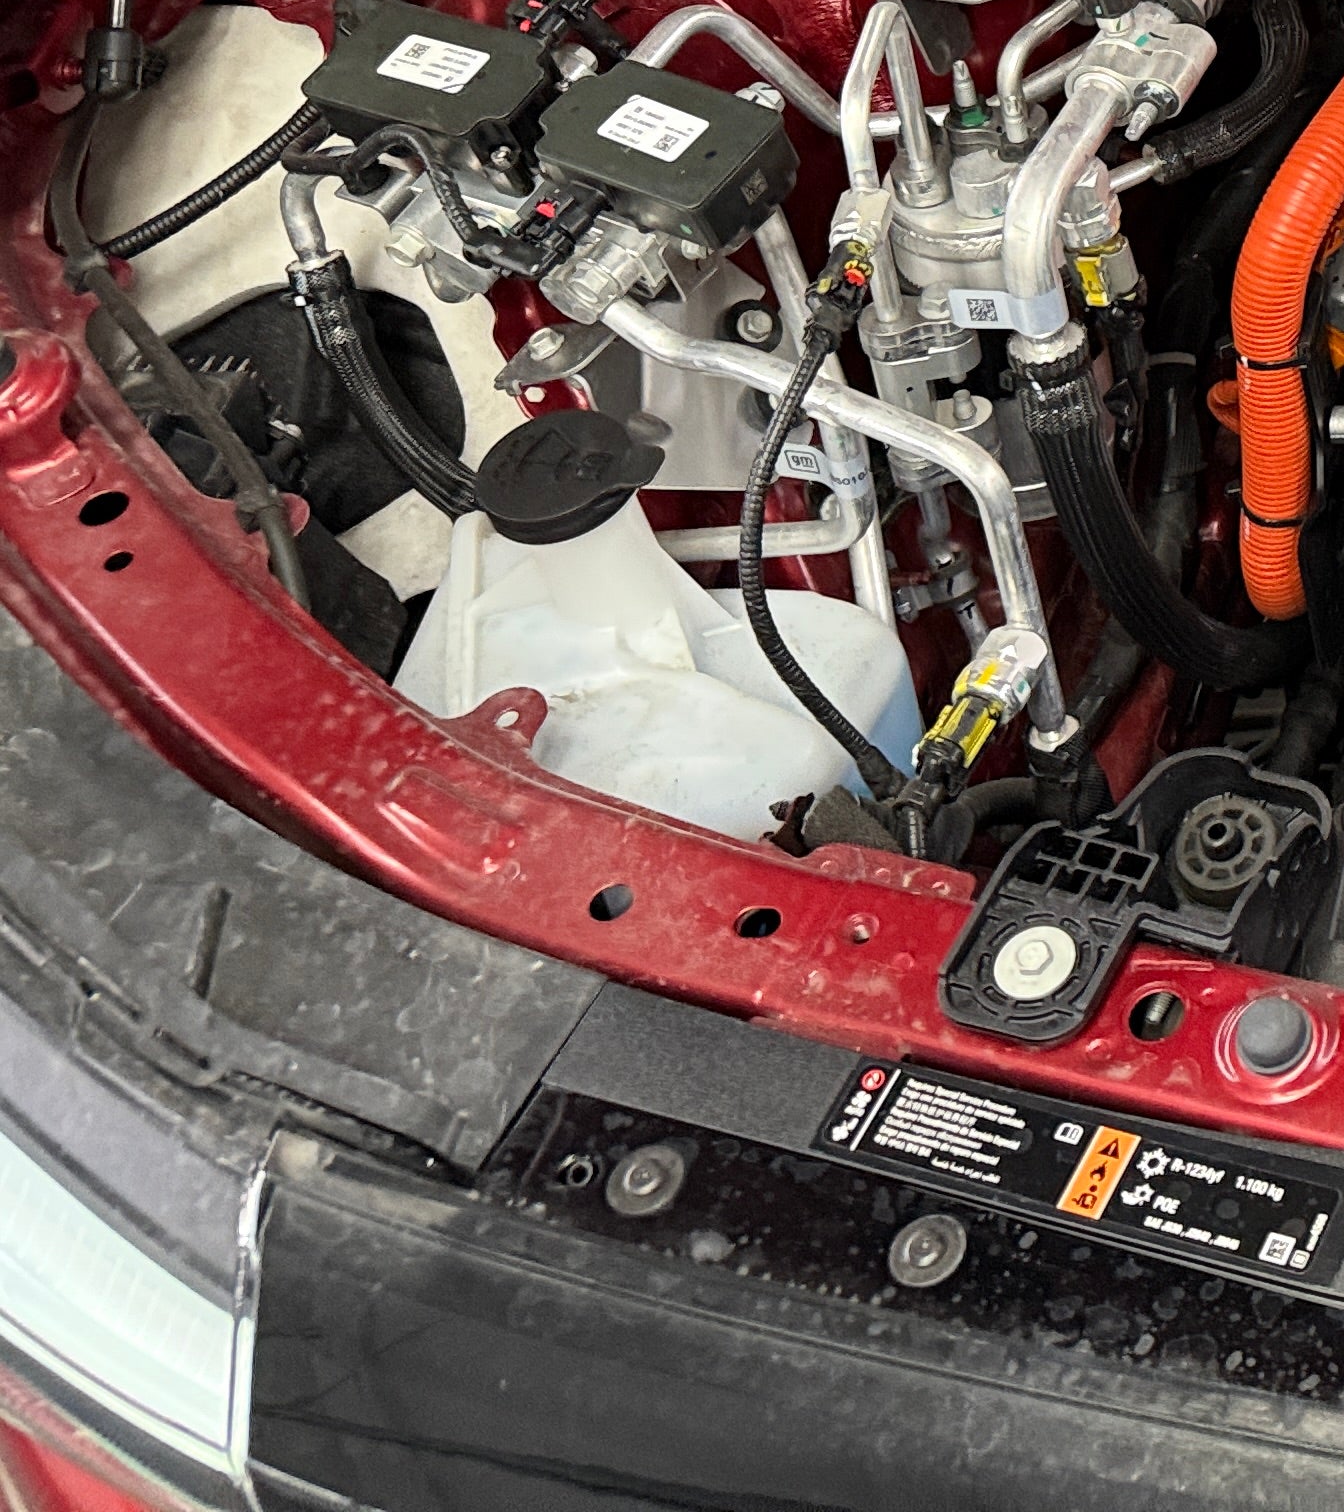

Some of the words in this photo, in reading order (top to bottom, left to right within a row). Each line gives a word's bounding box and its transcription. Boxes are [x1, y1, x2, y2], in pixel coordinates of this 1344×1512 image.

[1171, 1158, 1225, 1185] R-1234yf
[1267, 1184, 1285, 1202] kg
[1153, 1196, 1181, 1215] POE
